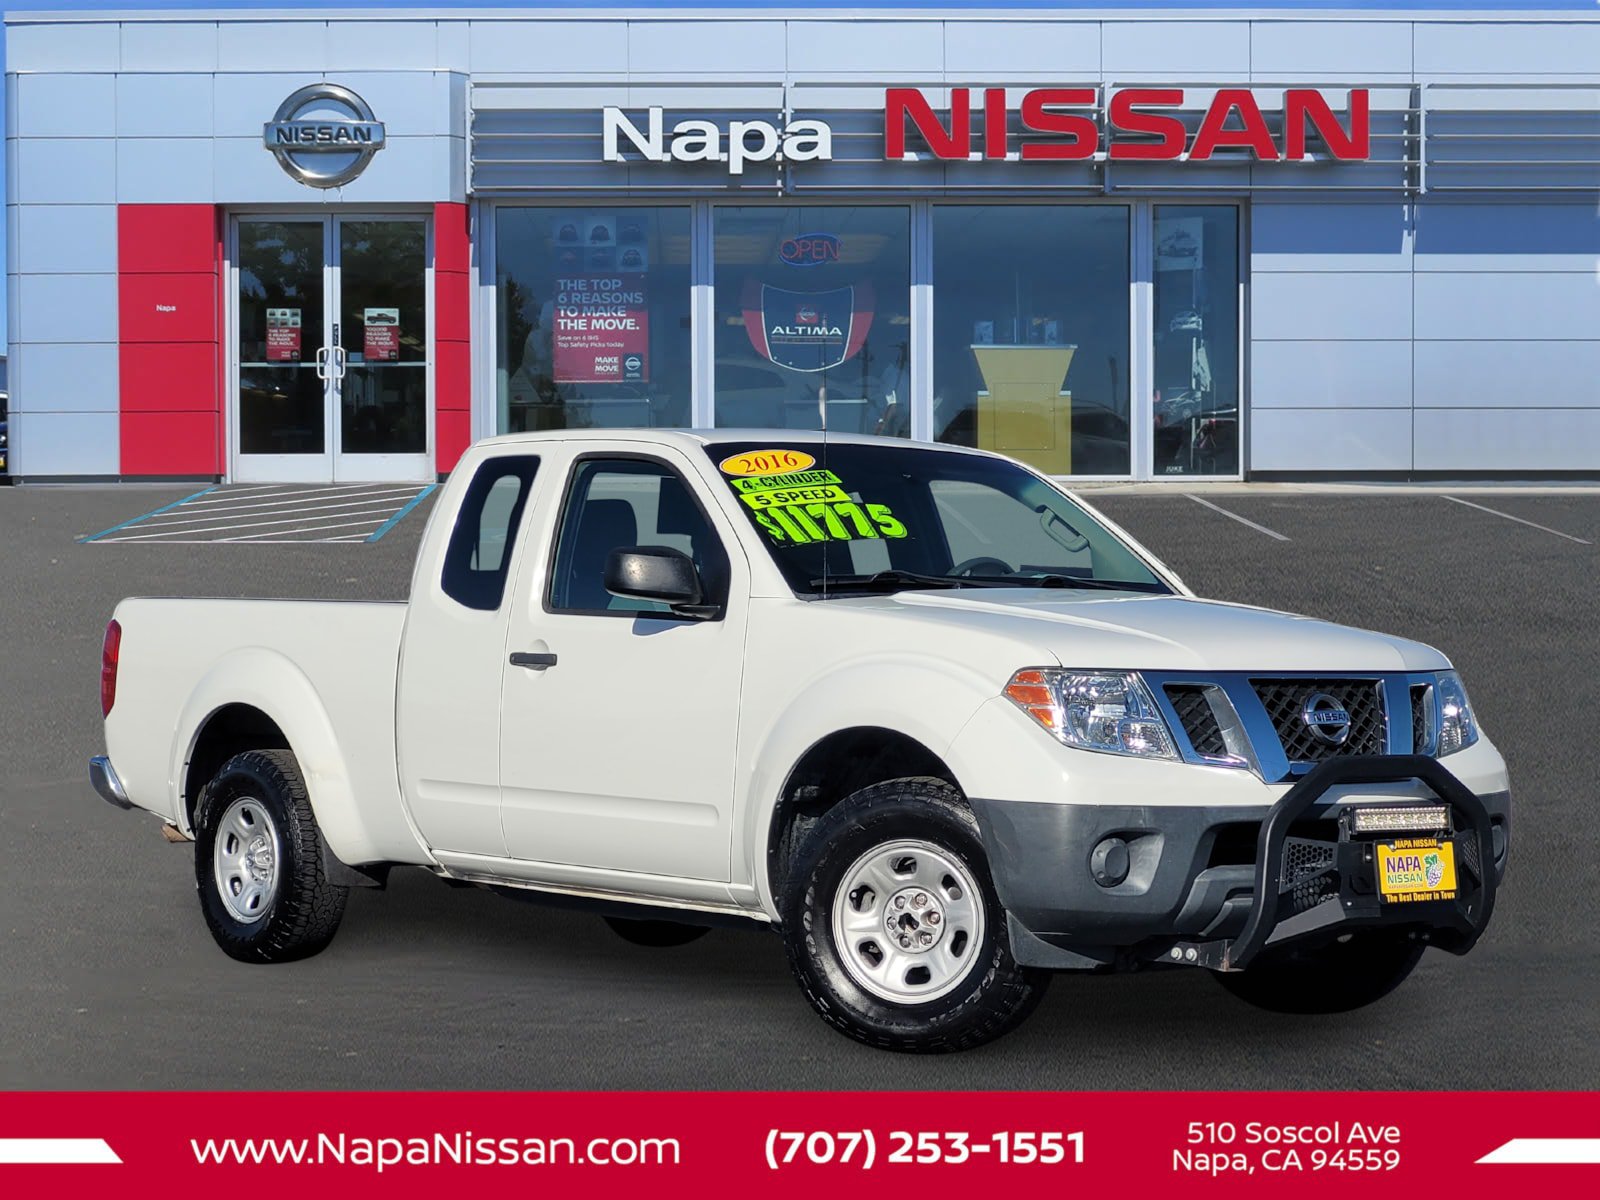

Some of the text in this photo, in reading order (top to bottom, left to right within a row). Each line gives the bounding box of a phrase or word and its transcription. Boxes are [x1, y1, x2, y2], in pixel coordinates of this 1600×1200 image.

[275, 125, 372, 144] NISSAN
[602, 88, 1370, 174] Napa NISSAN
[780, 239, 843, 261] OPEN
[557, 279, 622, 291] THE TOP
[557, 292, 643, 304] 6 REASONS
[156, 304, 176, 312] Napa
[557, 305, 626, 317] TO MAKE
[557, 319, 640, 330] THE MOVE.
[772, 326, 842, 335] ALTIMA
[739, 452, 798, 473] 2016
[754, 503, 908, 543] $11775
[1313, 711, 1346, 722] NISSAN
[1394, 838, 1437, 849] NAPA NISSAN
[1386, 855, 1421, 873] NAPA
[1387, 873, 1423, 884] NISSAN
[1386, 894, 1398, 903] The
[1399, 893, 1412, 902] Best
[1413, 892, 1432, 901] Dealer
[1440, 890, 1456, 900] Town
